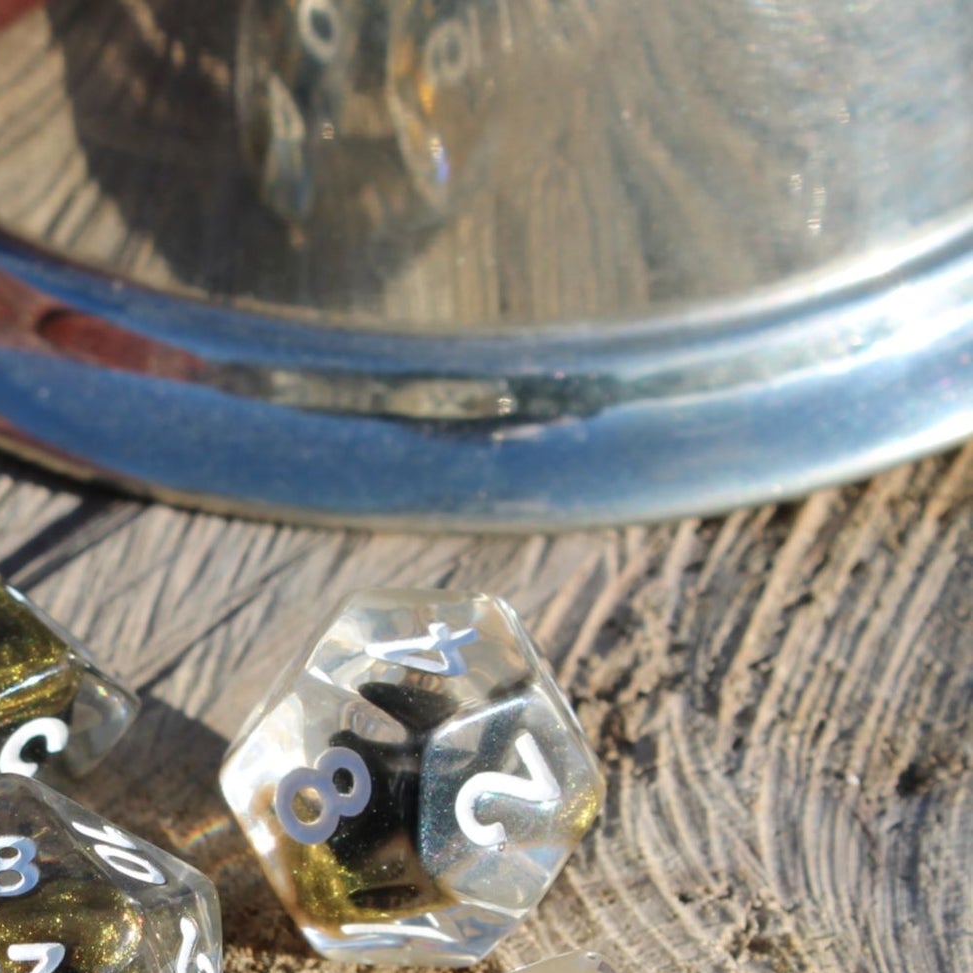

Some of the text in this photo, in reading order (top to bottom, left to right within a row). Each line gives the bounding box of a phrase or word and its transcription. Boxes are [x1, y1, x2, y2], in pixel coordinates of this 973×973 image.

[365, 622, 479, 676] 4
[275, 746, 372, 845] 8
[455, 732, 562, 848] 2
